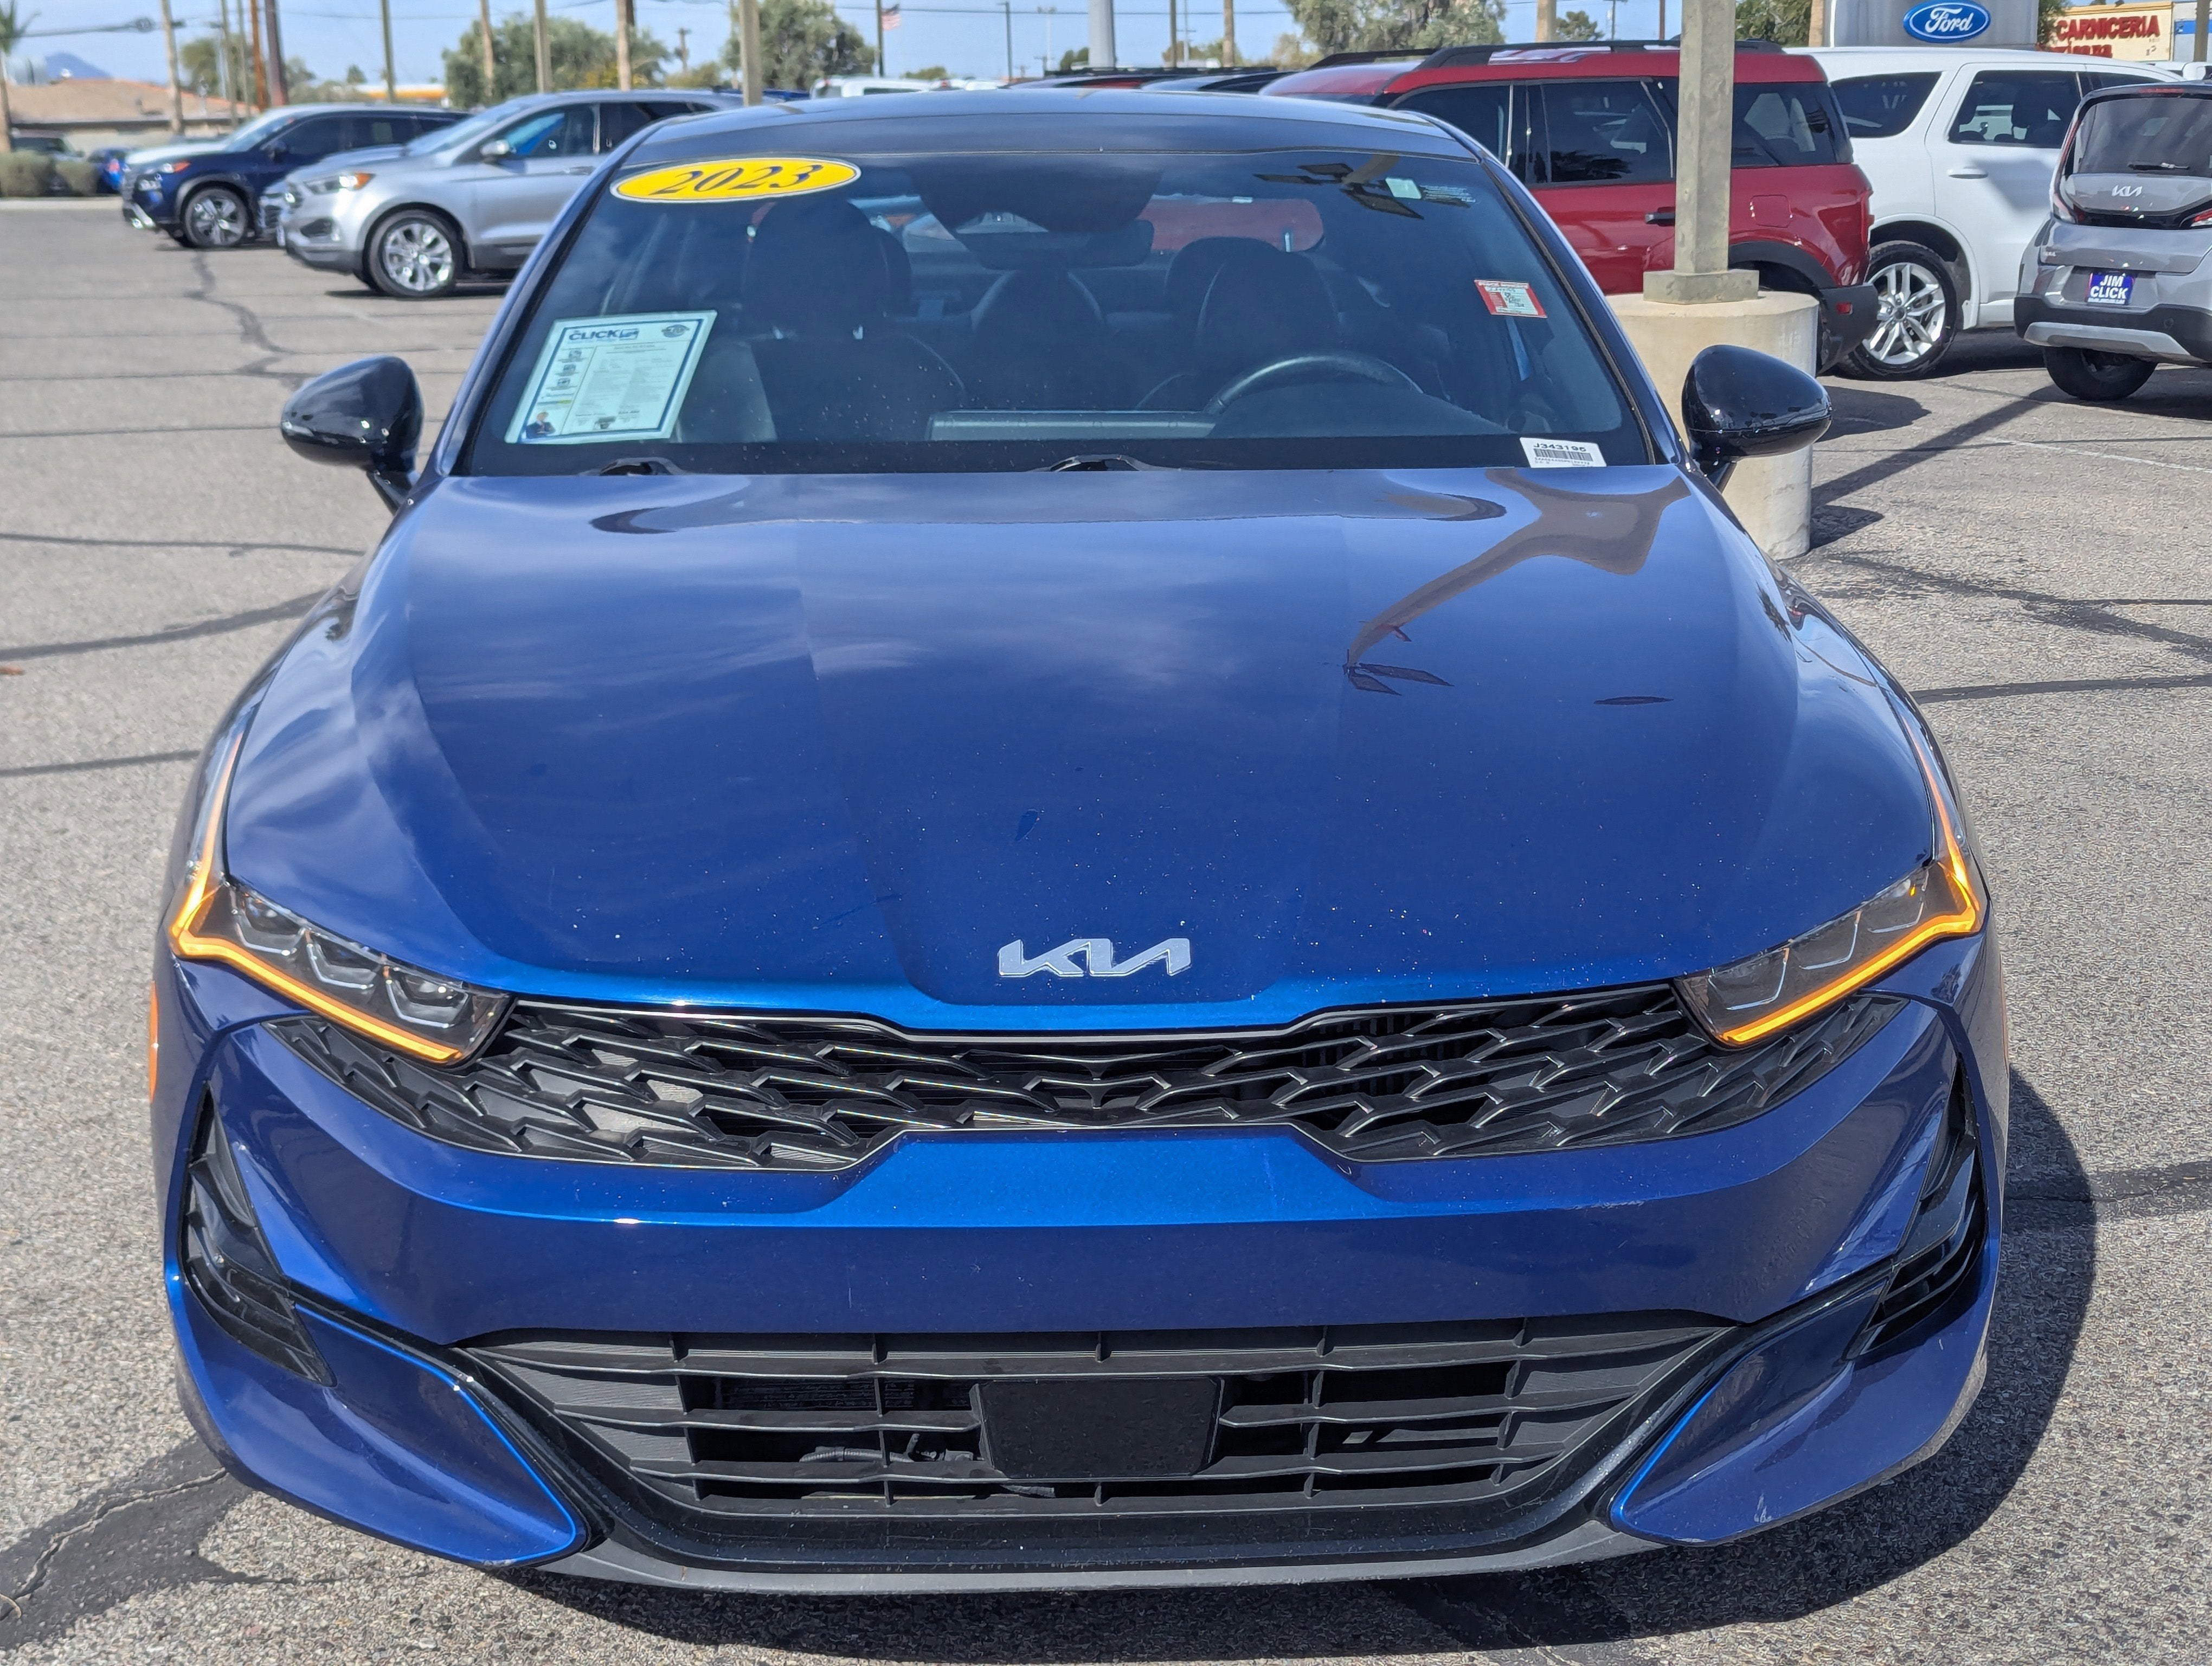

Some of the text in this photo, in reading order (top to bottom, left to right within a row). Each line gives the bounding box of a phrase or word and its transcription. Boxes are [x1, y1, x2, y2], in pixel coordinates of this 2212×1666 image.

[1925, 7, 1975, 33] Ford
[2056, 15, 2160, 41] CARNICERIA
[647, 164, 824, 196] 2023
[2111, 185, 2143, 197] KIA
[2099, 274, 2124, 287] JIM
[2090, 285, 2129, 299] CLICK
[568, 329, 621, 341] CLICK
[998, 938, 1192, 977] KIA
